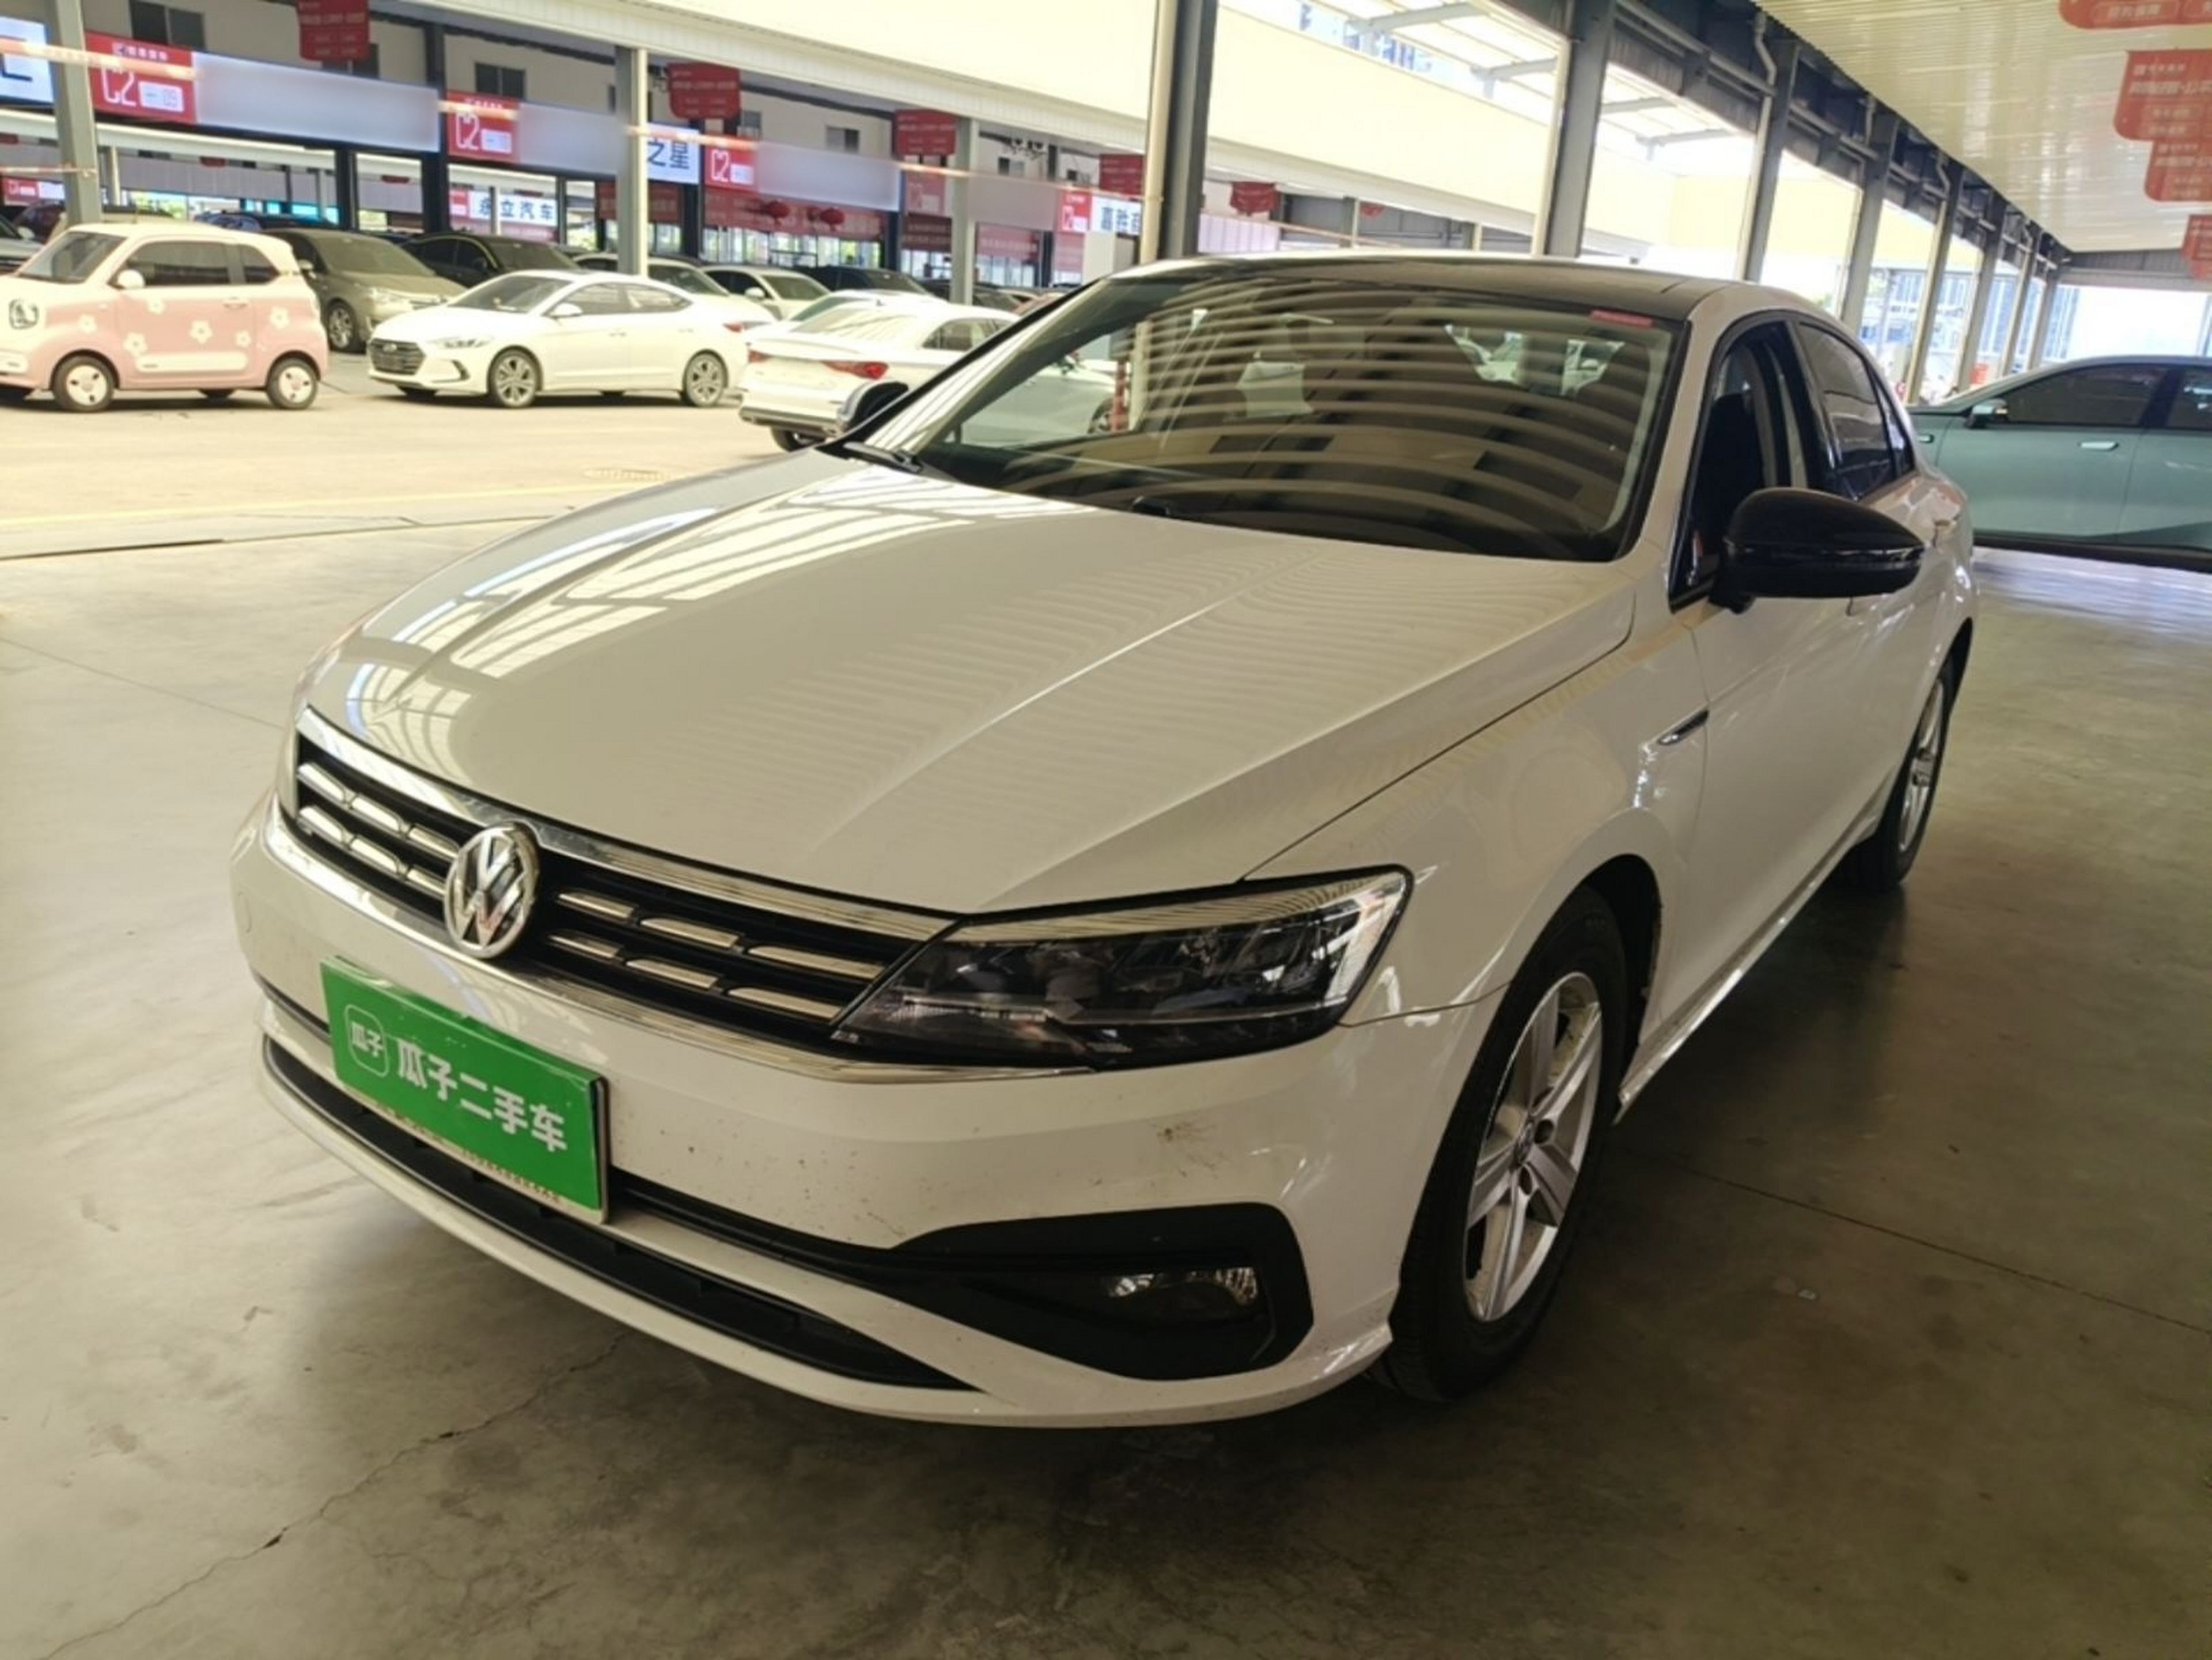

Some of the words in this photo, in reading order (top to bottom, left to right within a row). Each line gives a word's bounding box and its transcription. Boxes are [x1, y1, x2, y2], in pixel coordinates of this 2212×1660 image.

[647, 137, 690, 169] 之星
[351, 1020, 384, 1058] 瓜子
[396, 1037, 569, 1152] 瓜子二手车
